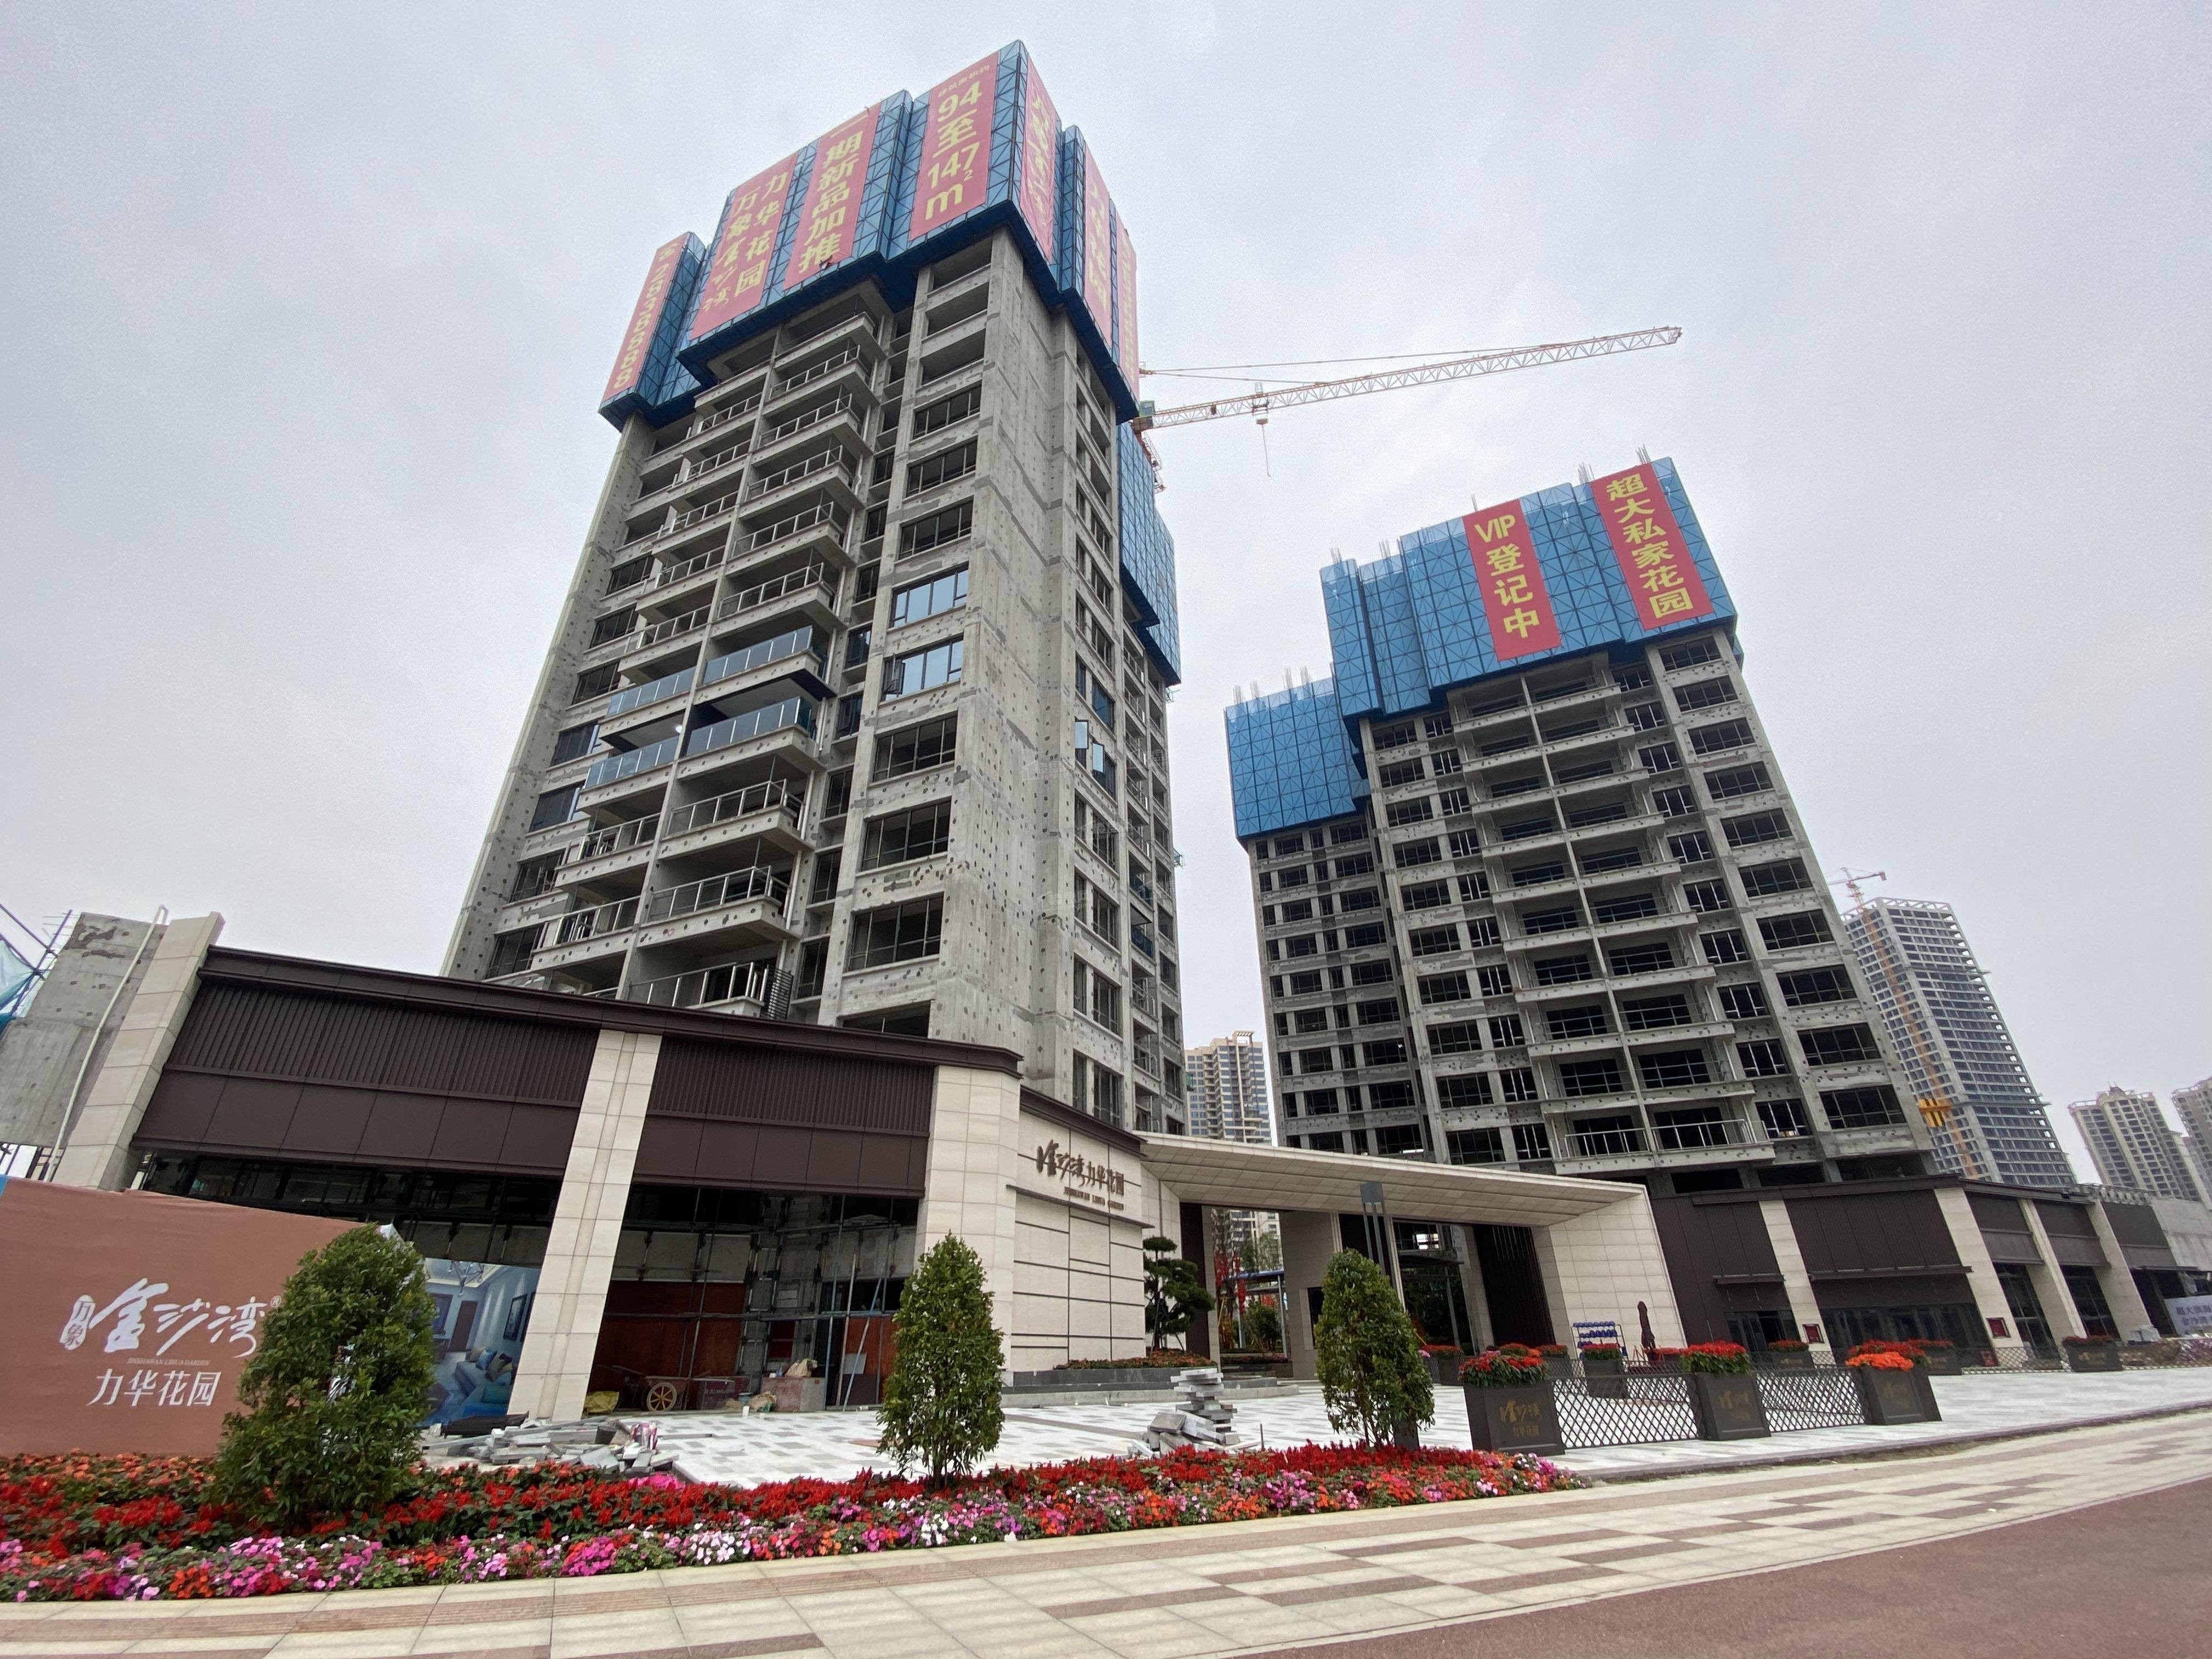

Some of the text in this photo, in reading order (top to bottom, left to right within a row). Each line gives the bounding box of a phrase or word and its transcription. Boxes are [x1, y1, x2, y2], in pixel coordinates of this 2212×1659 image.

[733, 171, 789, 298] 力华花园
[1606, 473, 1694, 618] 超大私家花园
[85, 1368, 222, 1407] 力华花园
